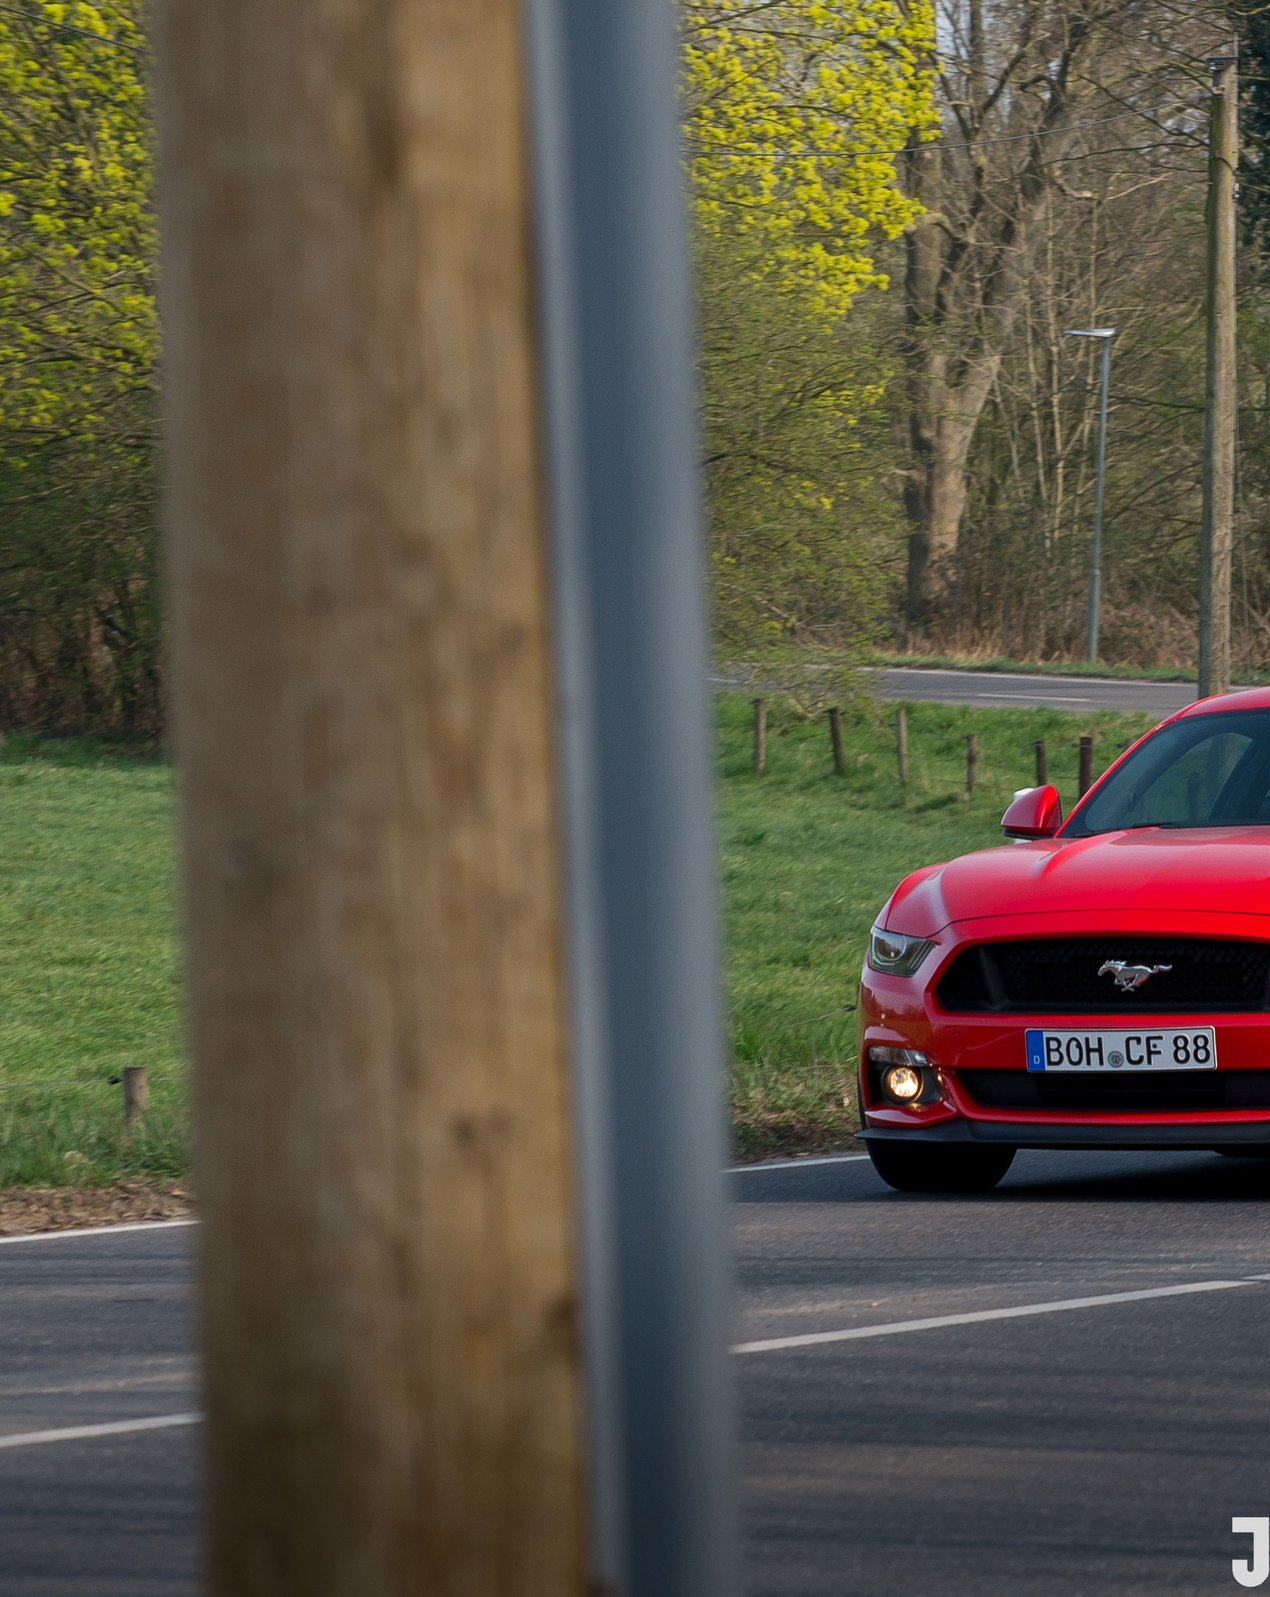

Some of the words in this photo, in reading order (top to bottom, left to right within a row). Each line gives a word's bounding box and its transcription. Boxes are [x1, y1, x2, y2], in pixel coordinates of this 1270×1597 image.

[1033, 1055, 1041, 1064] D
[1045, 1036, 1104, 1067] BOH
[1125, 1035, 1164, 1066] CF
[1172, 1034, 1211, 1065] 88
